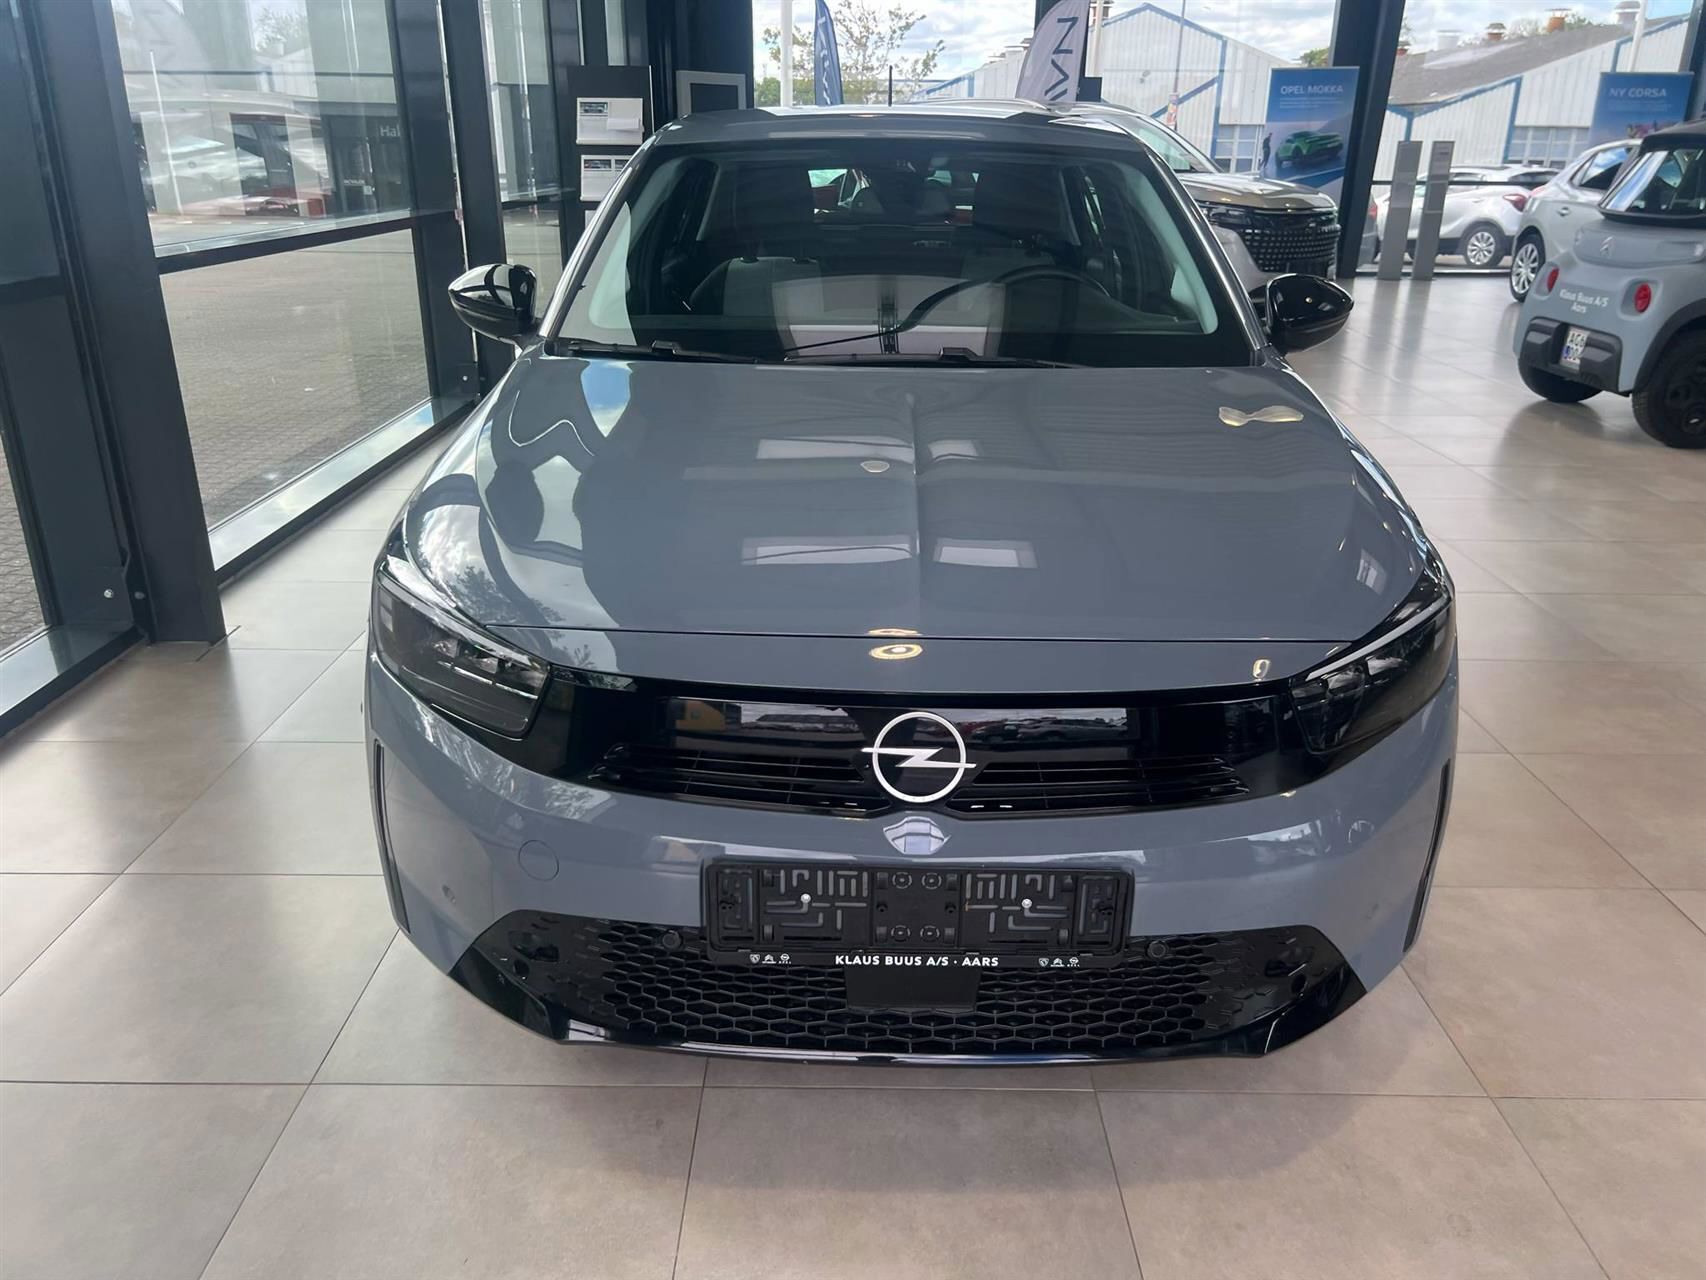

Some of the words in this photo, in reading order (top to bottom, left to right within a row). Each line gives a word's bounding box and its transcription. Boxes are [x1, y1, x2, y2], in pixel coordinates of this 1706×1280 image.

[1281, 85, 1305, 95] OPEL
[1307, 84, 1344, 94] MOKKA
[1608, 87, 1627, 97] NY
[1627, 87, 1667, 97] CORSA
[1560, 288, 1577, 301] Klaus
[1577, 292, 1594, 304] Buus
[1594, 296, 1609, 307] A/S
[835, 955, 880, 965] KLAUS
[885, 955, 922, 966] BUUS
[926, 956, 949, 966] A/S
[961, 957, 999, 967] AARS
